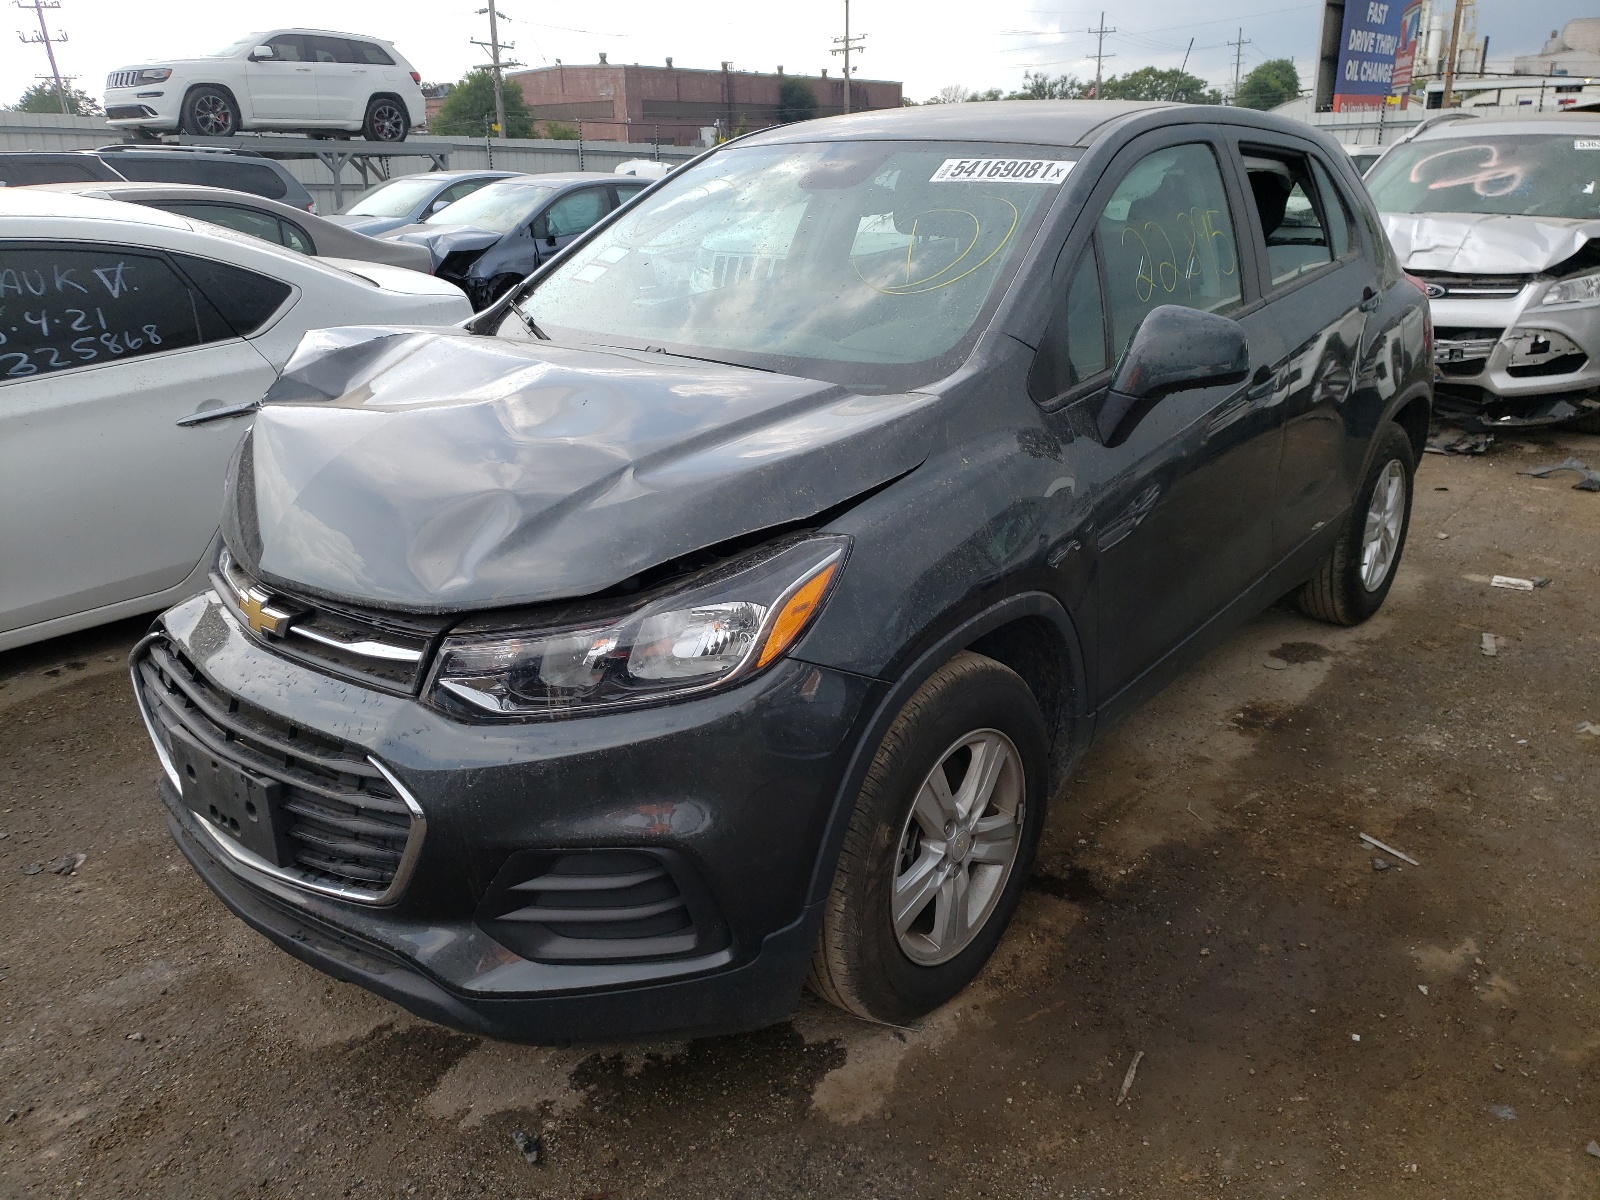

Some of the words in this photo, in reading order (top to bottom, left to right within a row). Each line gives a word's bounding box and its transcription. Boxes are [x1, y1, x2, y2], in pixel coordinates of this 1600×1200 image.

[1367, 2, 1389, 25] FAST
[1348, 29, 1375, 53] DRIVE
[1375, 33, 1398, 56] THRU
[1345, 59, 1359, 81] OIL
[1361, 61, 1394, 84] CHANGE
[950, 160, 1055, 179] 54169081
